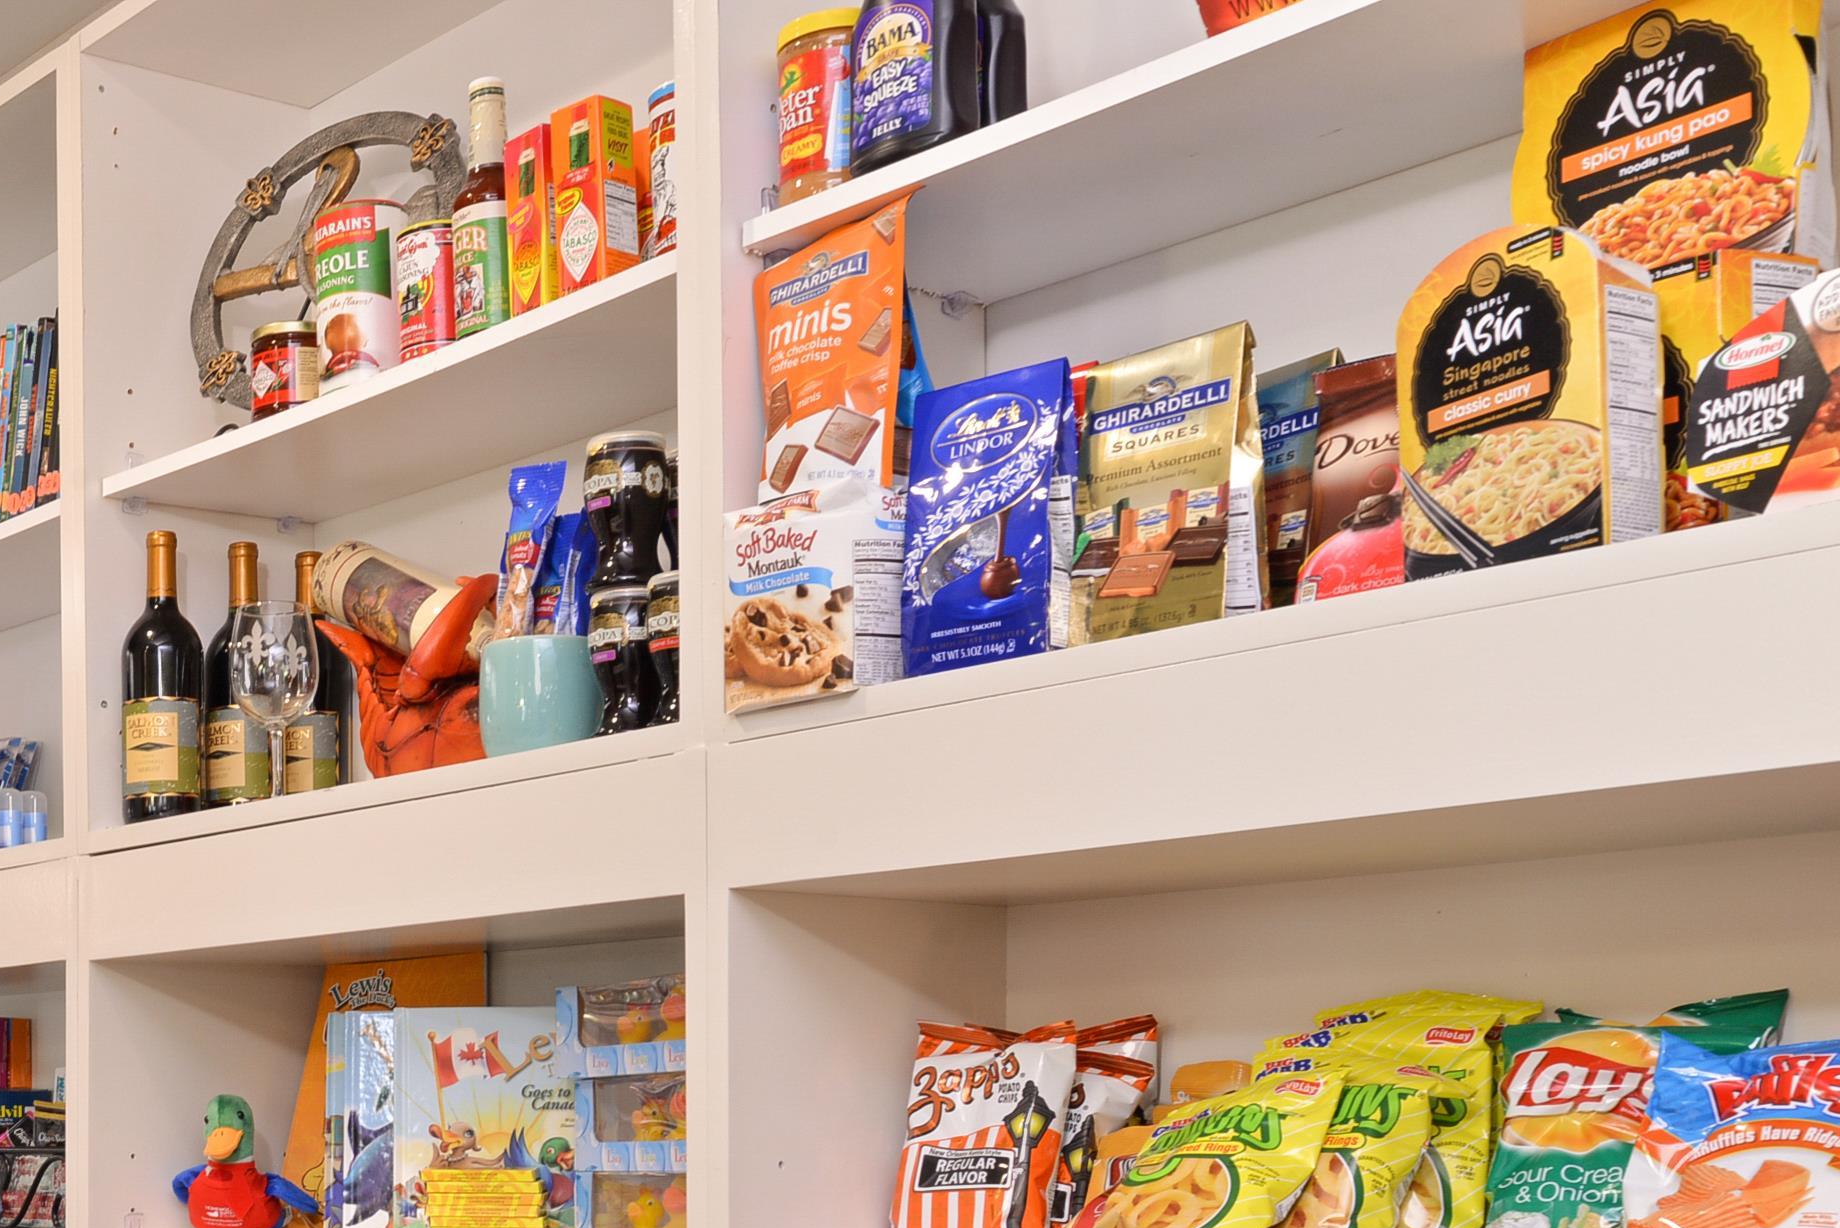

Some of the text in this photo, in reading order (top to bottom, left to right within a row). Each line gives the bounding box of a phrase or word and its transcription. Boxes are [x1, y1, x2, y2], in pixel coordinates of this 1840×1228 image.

[866, 21, 917, 60] BAMA
[870, 57, 906, 88] EASY
[1624, 51, 1686, 83] SIMPLY
[863, 74, 918, 112] SQUEEZE
[1597, 67, 1706, 137] Asia
[871, 118, 902, 138] JELLY
[1581, 108, 1730, 170] spicy kung pao
[608, 138, 628, 154] VISIT
[1618, 156, 1659, 178] noodle
[1661, 145, 1690, 165] bowl
[770, 258, 865, 304] GHIRARDELLI
[1754, 262, 1790, 273] Nutrition
[1465, 293, 1510, 317] SIMPLY
[768, 301, 852, 354] minis
[1446, 307, 1524, 361] Asia
[786, 336, 842, 358] chocolate
[800, 350, 830, 367] crisp
[1727, 337, 1784, 363] Hormel
[1442, 344, 1530, 386] Singapore
[1442, 363, 1530, 401] street noodles
[44, 368, 58, 437] NIGHTCRAWLER
[797, 392, 822, 409] minis
[1093, 383, 1229, 432] GHIRARDELLI
[1443, 394, 1492, 422] classic
[1495, 381, 1531, 408] curry
[1697, 375, 1805, 425] SANDWICH
[15, 396, 28, 457] JOHN WICK
[1111, 423, 1201, 454] SQUARES
[1705, 405, 1789, 447] MAKERS
[950, 432, 1013, 461] LINDOR
[1086, 459, 1144, 486] Premium
[1146, 446, 1222, 471] Assortment
[736, 527, 817, 567] Soft Baked
[747, 553, 802, 578] Montauk
[745, 572, 810, 594] Milk Chocolate
[932, 648, 959, 663] NET WT
[130, 727, 167, 738] CREEK
[329, 969, 393, 1009] Lewis
[521, 1083, 571, 1100] Goes to
[997, 1093, 1018, 1104] CHIPS
[998, 1082, 1020, 1093] POTATO
[1205, 1143, 1238, 1153] Rings
[1326, 1135, 1358, 1145] Rings
[1760, 1127, 1800, 1140] Have
[935, 1171, 987, 1186] FLAVOR
[936, 1157, 995, 1172] REGULAR
[1515, 1181, 1617, 1203] & Onion
